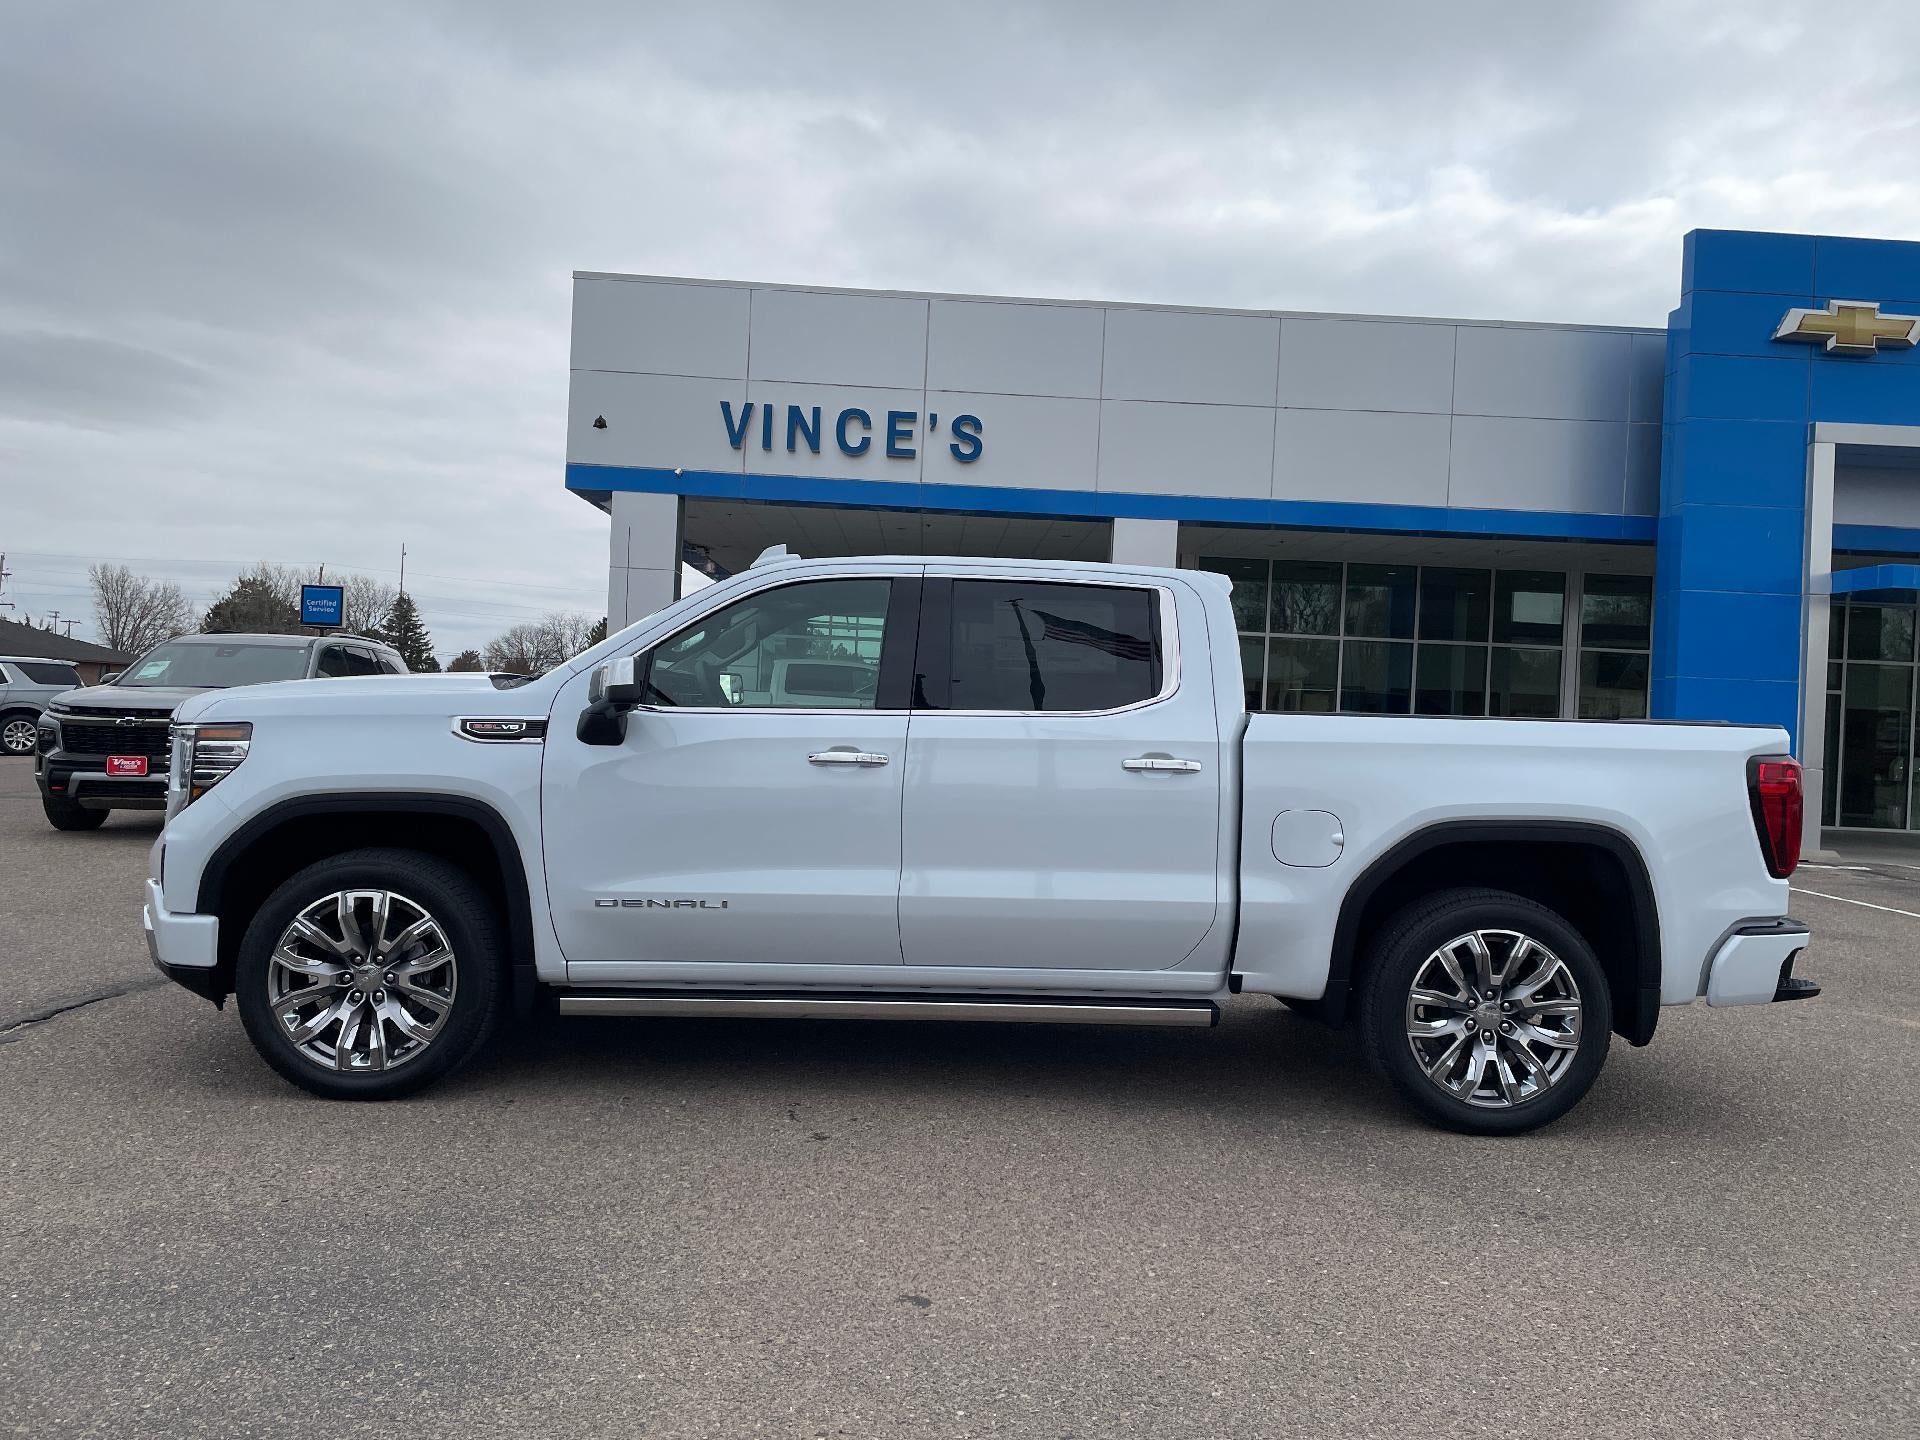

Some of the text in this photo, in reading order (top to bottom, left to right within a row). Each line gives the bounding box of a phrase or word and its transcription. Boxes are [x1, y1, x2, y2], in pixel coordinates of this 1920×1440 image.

[719, 400, 983, 463] VINCE'S
[306, 599, 337, 607] Certified
[308, 605, 335, 613] Service
[594, 898, 728, 909] DENALI
